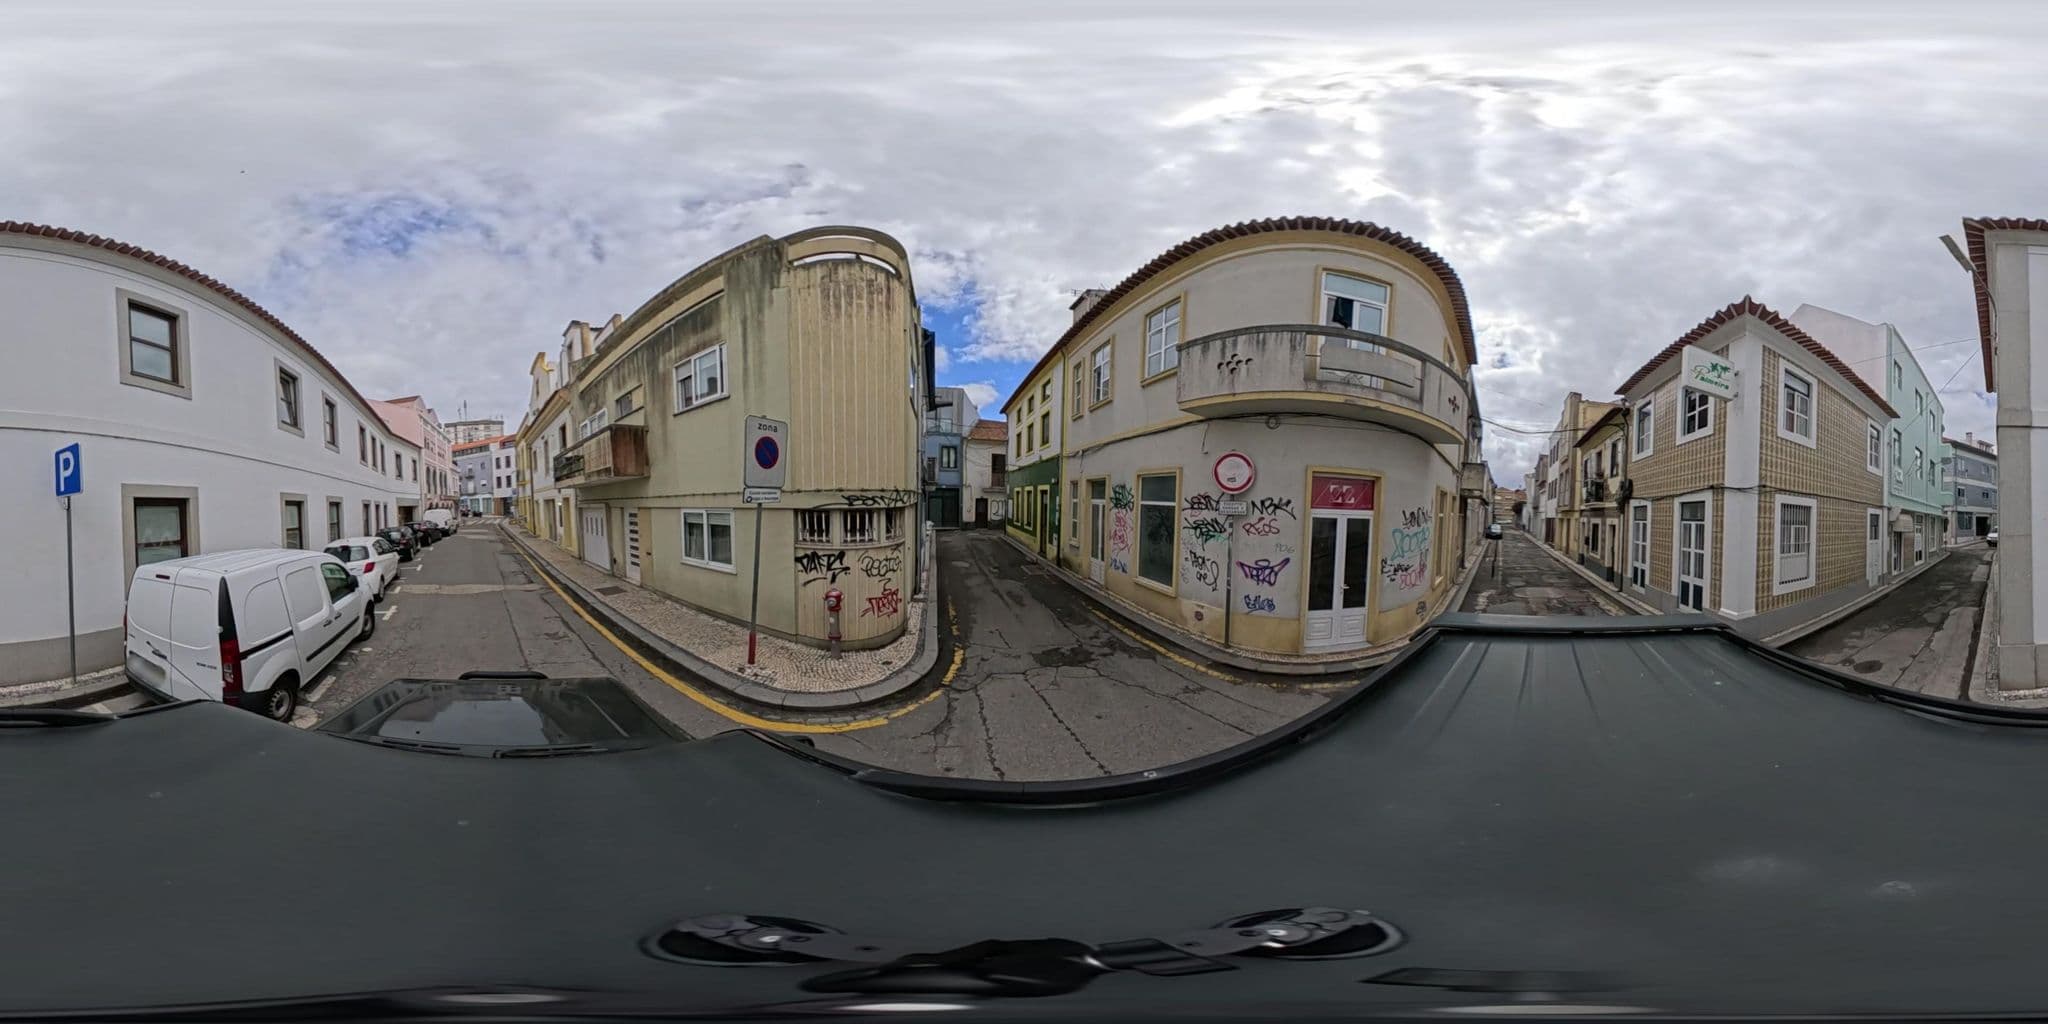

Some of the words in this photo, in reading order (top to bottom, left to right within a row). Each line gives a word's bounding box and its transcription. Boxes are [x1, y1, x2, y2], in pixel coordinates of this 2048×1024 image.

[1691, 365, 1729, 390] Palmeira
[757, 422, 778, 433] zona
[59, 451, 75, 492] P
